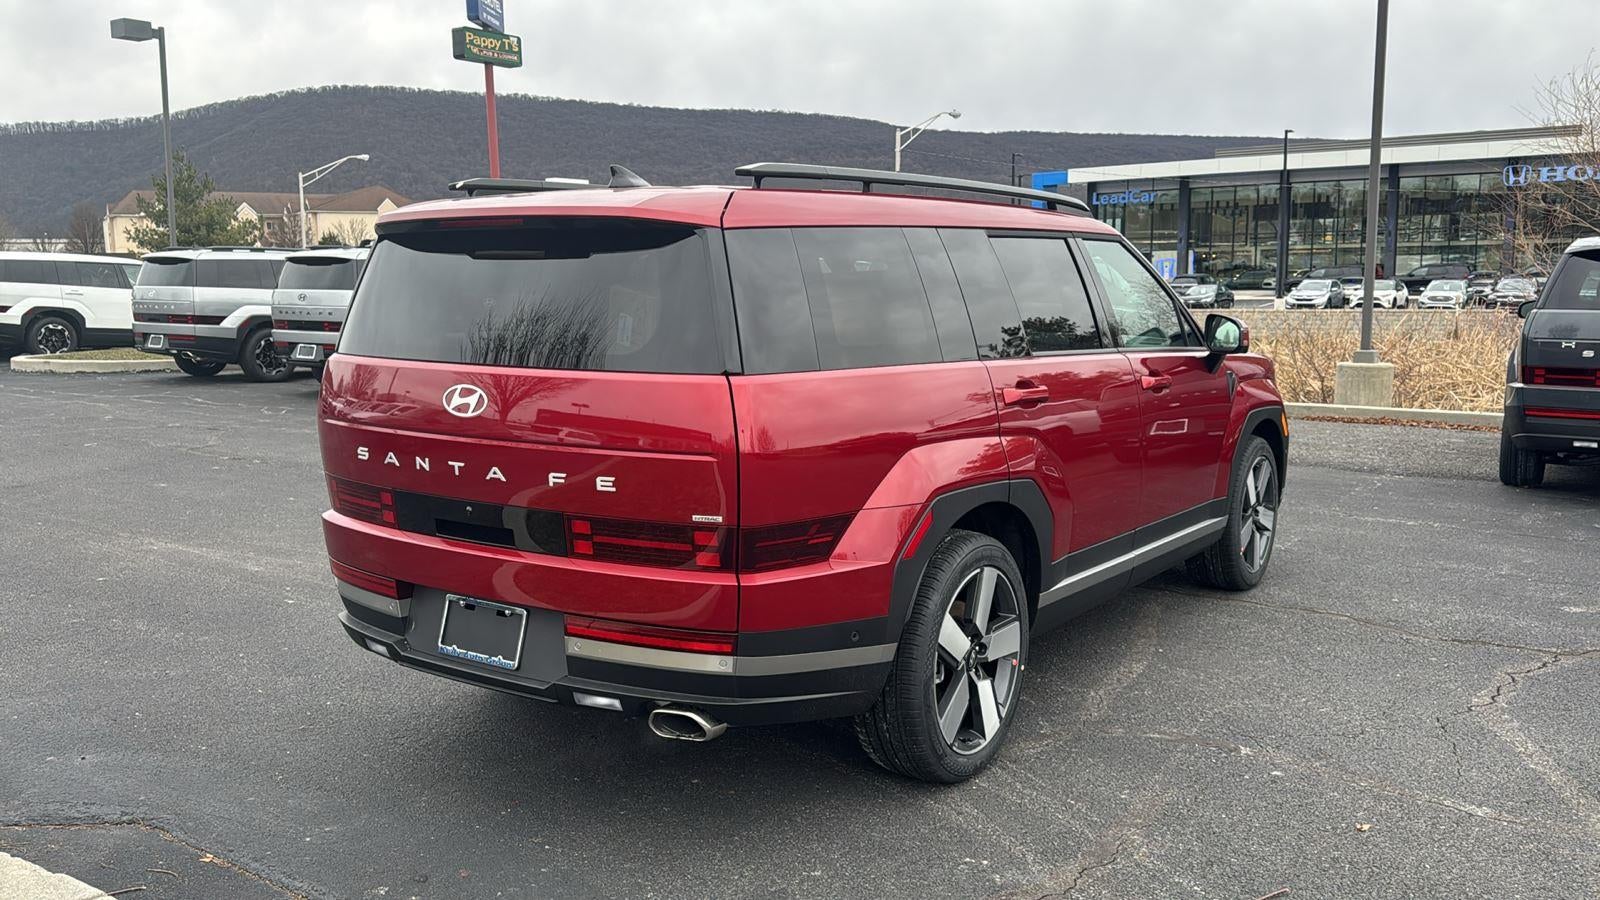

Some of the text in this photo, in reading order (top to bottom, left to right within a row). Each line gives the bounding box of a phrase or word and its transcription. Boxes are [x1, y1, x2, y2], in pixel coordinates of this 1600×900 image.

[465, 32, 501, 51] Pappy
[503, 37, 519, 52] T's
[1092, 188, 1157, 206] LeadCar
[357, 446, 617, 492] SANTA FE
